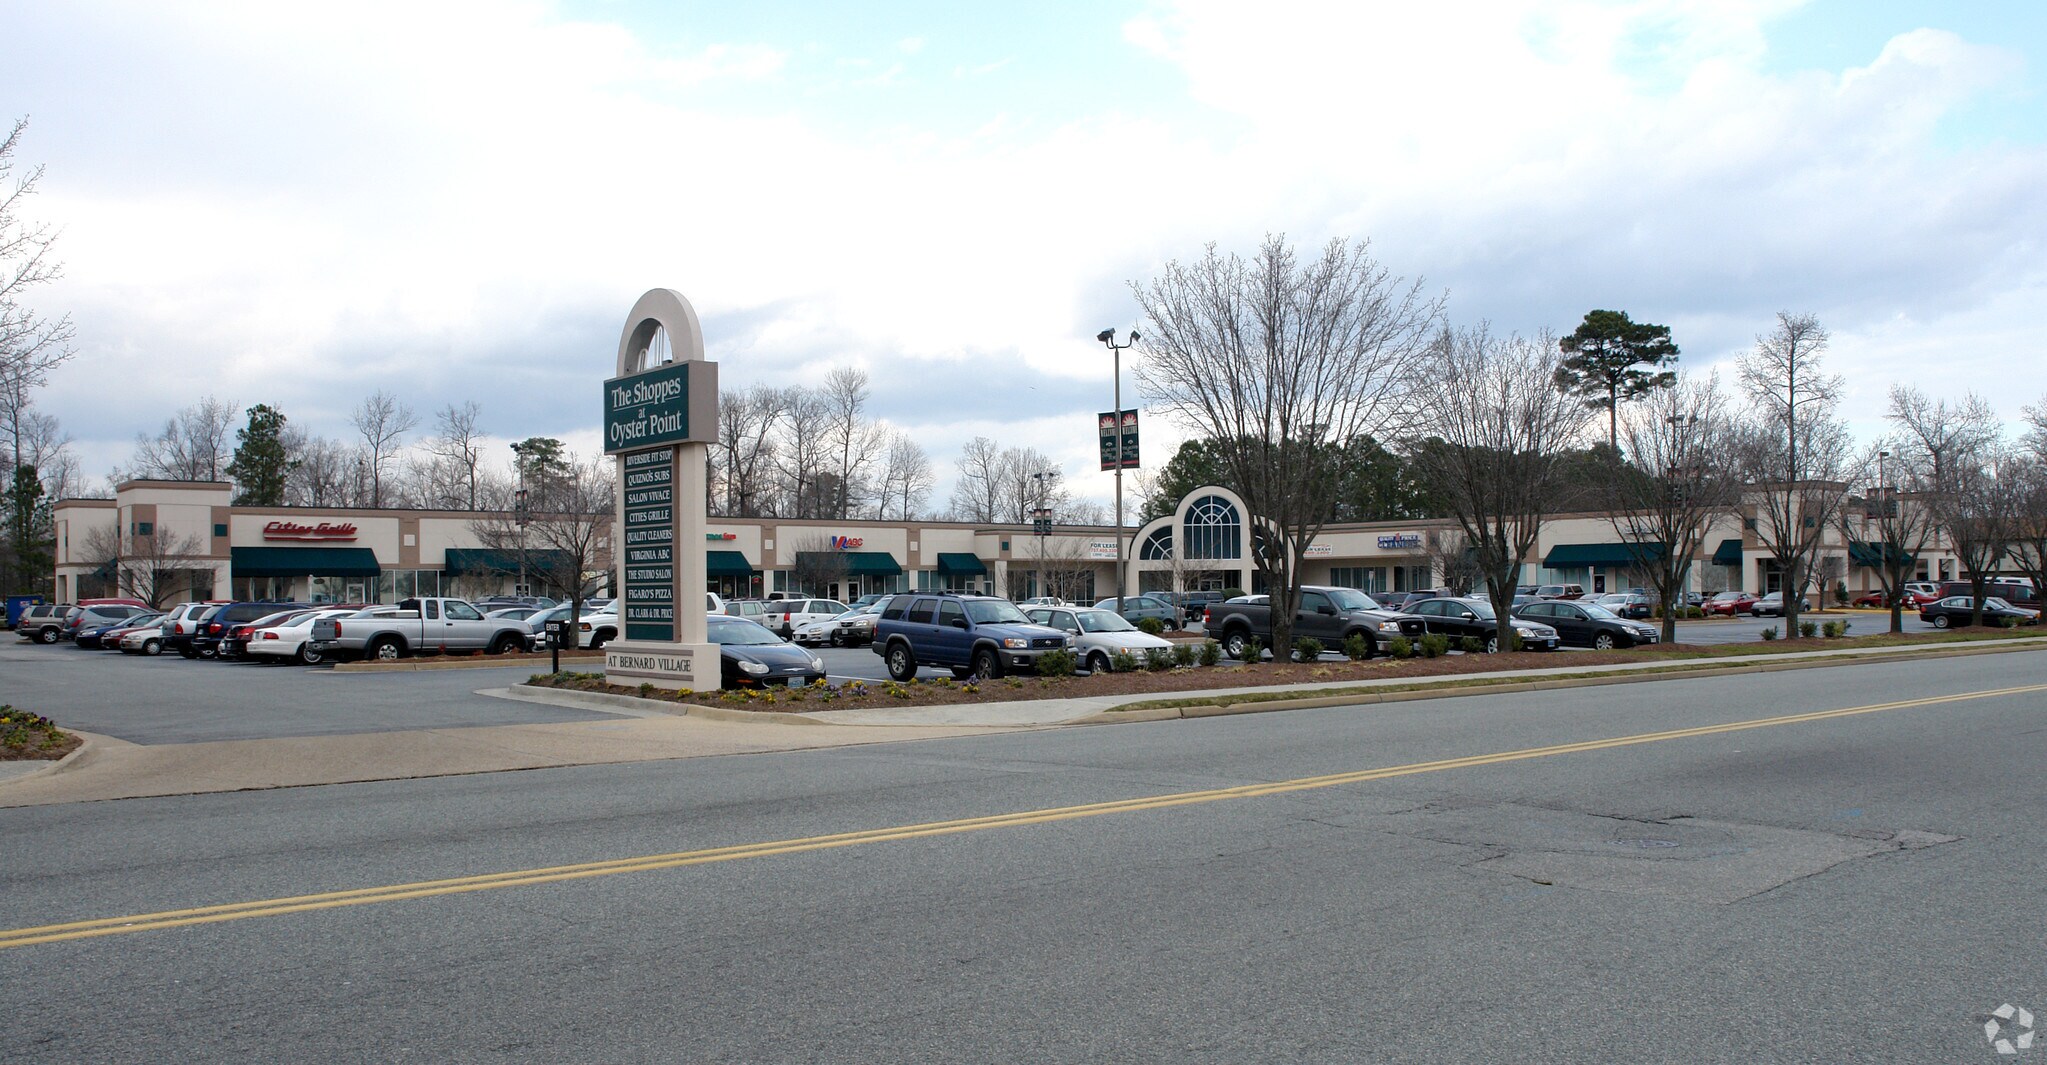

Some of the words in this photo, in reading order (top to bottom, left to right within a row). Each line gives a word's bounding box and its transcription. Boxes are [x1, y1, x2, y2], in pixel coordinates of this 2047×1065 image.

[612, 386, 631, 408] The
[634, 378, 681, 405] Shoppes
[638, 408, 645, 418] at
[611, 419, 647, 447] Oyster
[650, 410, 682, 435] Point
[626, 453, 651, 466] RIVERSIDE
[651, 452, 659, 462] FIT
[659, 450, 672, 461] STOP
[654, 470, 670, 481] SUBS
[628, 493, 648, 504] SALON
[648, 490, 670, 501] VIVACE
[629, 511, 647, 523] CITIES
[648, 510, 669, 521] GRILLE
[627, 531, 647, 543] QUALITY
[647, 529, 672, 540] CLEANERS
[846, 537, 863, 547] ABC
[630, 550, 656, 561] VIRGINIA
[657, 549, 670, 560] ABC
[627, 570, 638, 580] THE
[638, 569, 654, 579] STUDIO
[655, 569, 672, 579] SALON
[628, 589, 654, 599] FIGARO'S
[655, 588, 672, 599] PIZZA
[635, 609, 649, 618] CLARK
[660, 608, 673, 619] PRICE
[608, 655, 618, 667] AT
[620, 656, 655, 670] BERNARD
[658, 658, 691, 672] VILLAGE
